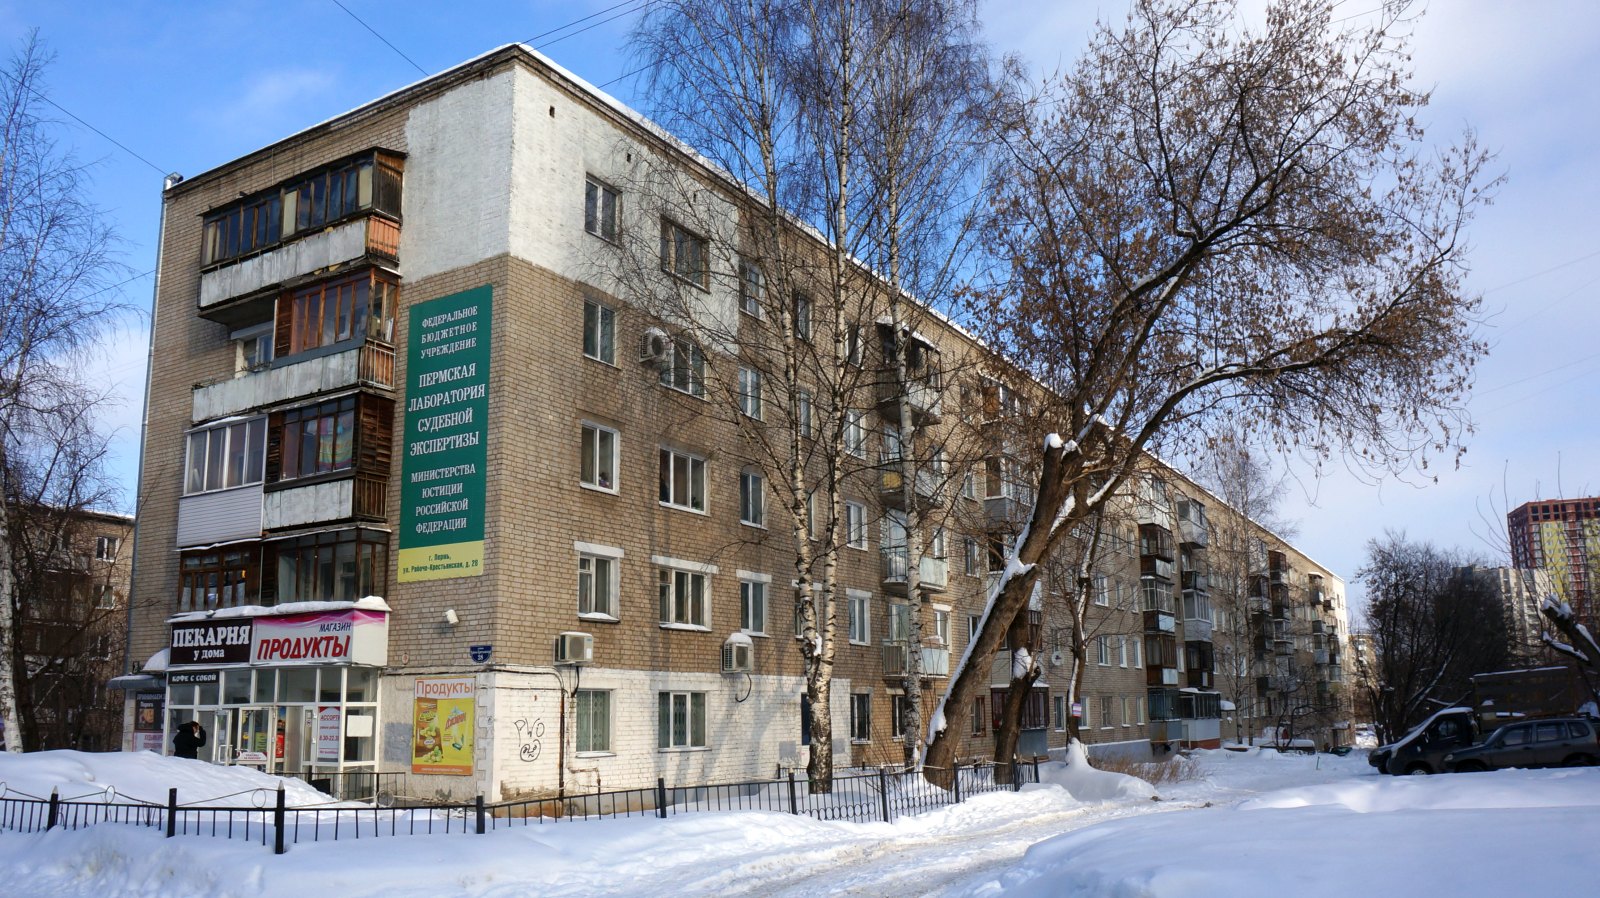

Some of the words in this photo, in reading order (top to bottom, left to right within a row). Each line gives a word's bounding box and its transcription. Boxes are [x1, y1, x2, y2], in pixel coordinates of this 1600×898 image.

[421, 305, 478, 329] ФЕДЕРАЛЬНОЕ
[421, 321, 477, 344] БЮДЖЕТНОЕ
[420, 337, 477, 359] УЧРЕЖДЕНИЕ
[418, 362, 476, 388] ПЕРМСКАЯ
[408, 383, 486, 412] ЛАБОРАТОРИЯ
[417, 407, 473, 433] СУДЕБНОЙ
[410, 431, 479, 457] ЭКСПЕРТИЗЫ
[410, 463, 476, 483] МИНИСТЕРСТВА
[421, 482, 463, 499] ЮСТИЦИИ
[415, 497, 469, 517] РОССИЙСКОЙ
[415, 517, 467, 534] ФЕДЕРАЦИИ
[434, 553, 451, 561] Пермь,
[172, 625, 250, 648] ПЕКАРНЯ
[319, 622, 352, 633] МАГАЗИН
[193, 651, 200, 661] у
[201, 648, 225, 658] дома
[257, 635, 351, 660] ПРОДУКТЫ
[171, 675, 189, 683] КОФЕ
[195, 674, 217, 682] СОБОЙ
[416, 681, 473, 697] Продукты
